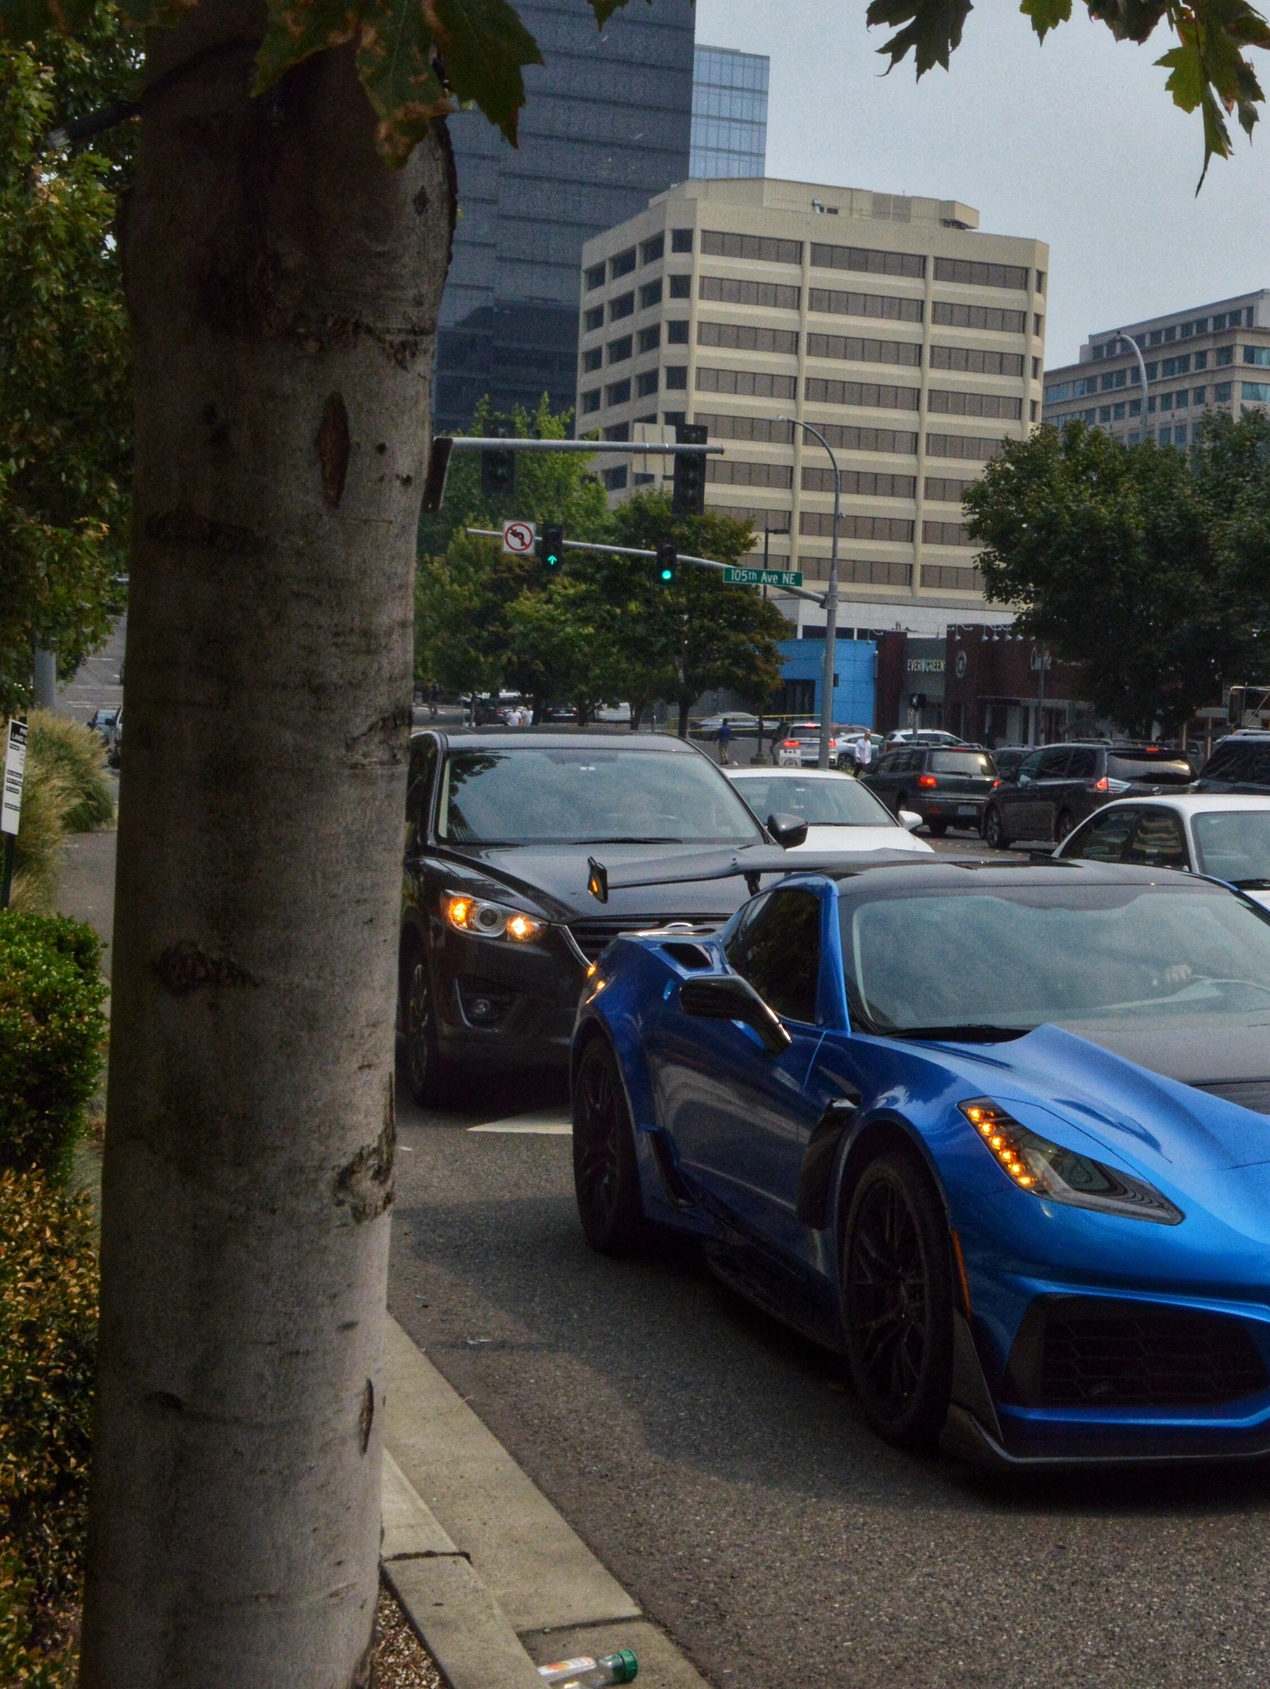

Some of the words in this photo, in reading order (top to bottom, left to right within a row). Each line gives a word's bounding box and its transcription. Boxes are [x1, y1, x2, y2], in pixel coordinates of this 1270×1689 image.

[731, 569, 757, 581] 105th
[761, 572, 778, 584] Ave
[782, 573, 796, 585] NE
